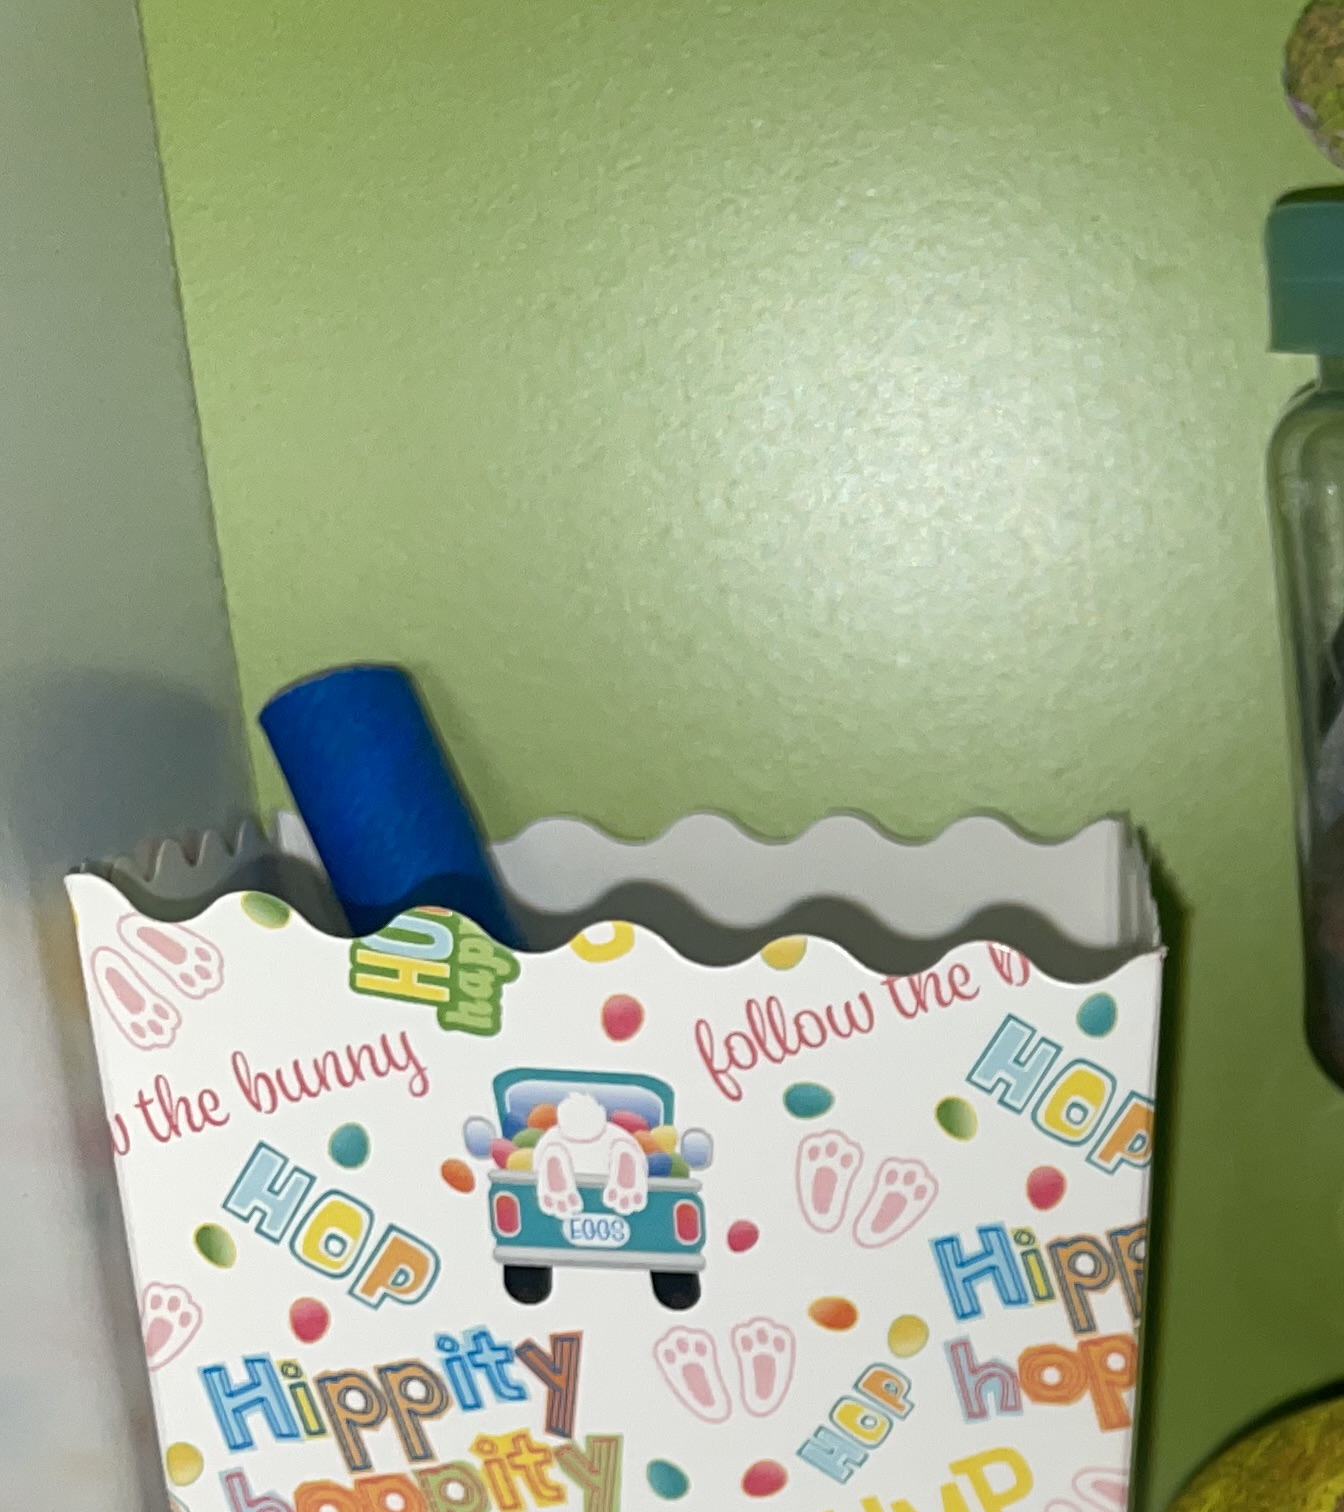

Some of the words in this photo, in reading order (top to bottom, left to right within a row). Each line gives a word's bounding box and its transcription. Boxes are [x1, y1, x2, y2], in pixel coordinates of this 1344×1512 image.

[355, 906, 453, 1001] HO
[134, 1074, 231, 1143] the
[232, 1030, 430, 1114] bunny
[694, 991, 875, 1102] follow
[881, 962, 980, 1021] the
[964, 1013, 1155, 1177] HOP
[222, 1140, 442, 1310] HOP
[198, 1325, 584, 1473] Hippity
[796, 1361, 915, 1485] HOP
[944, 1332, 1139, 1433] hop
